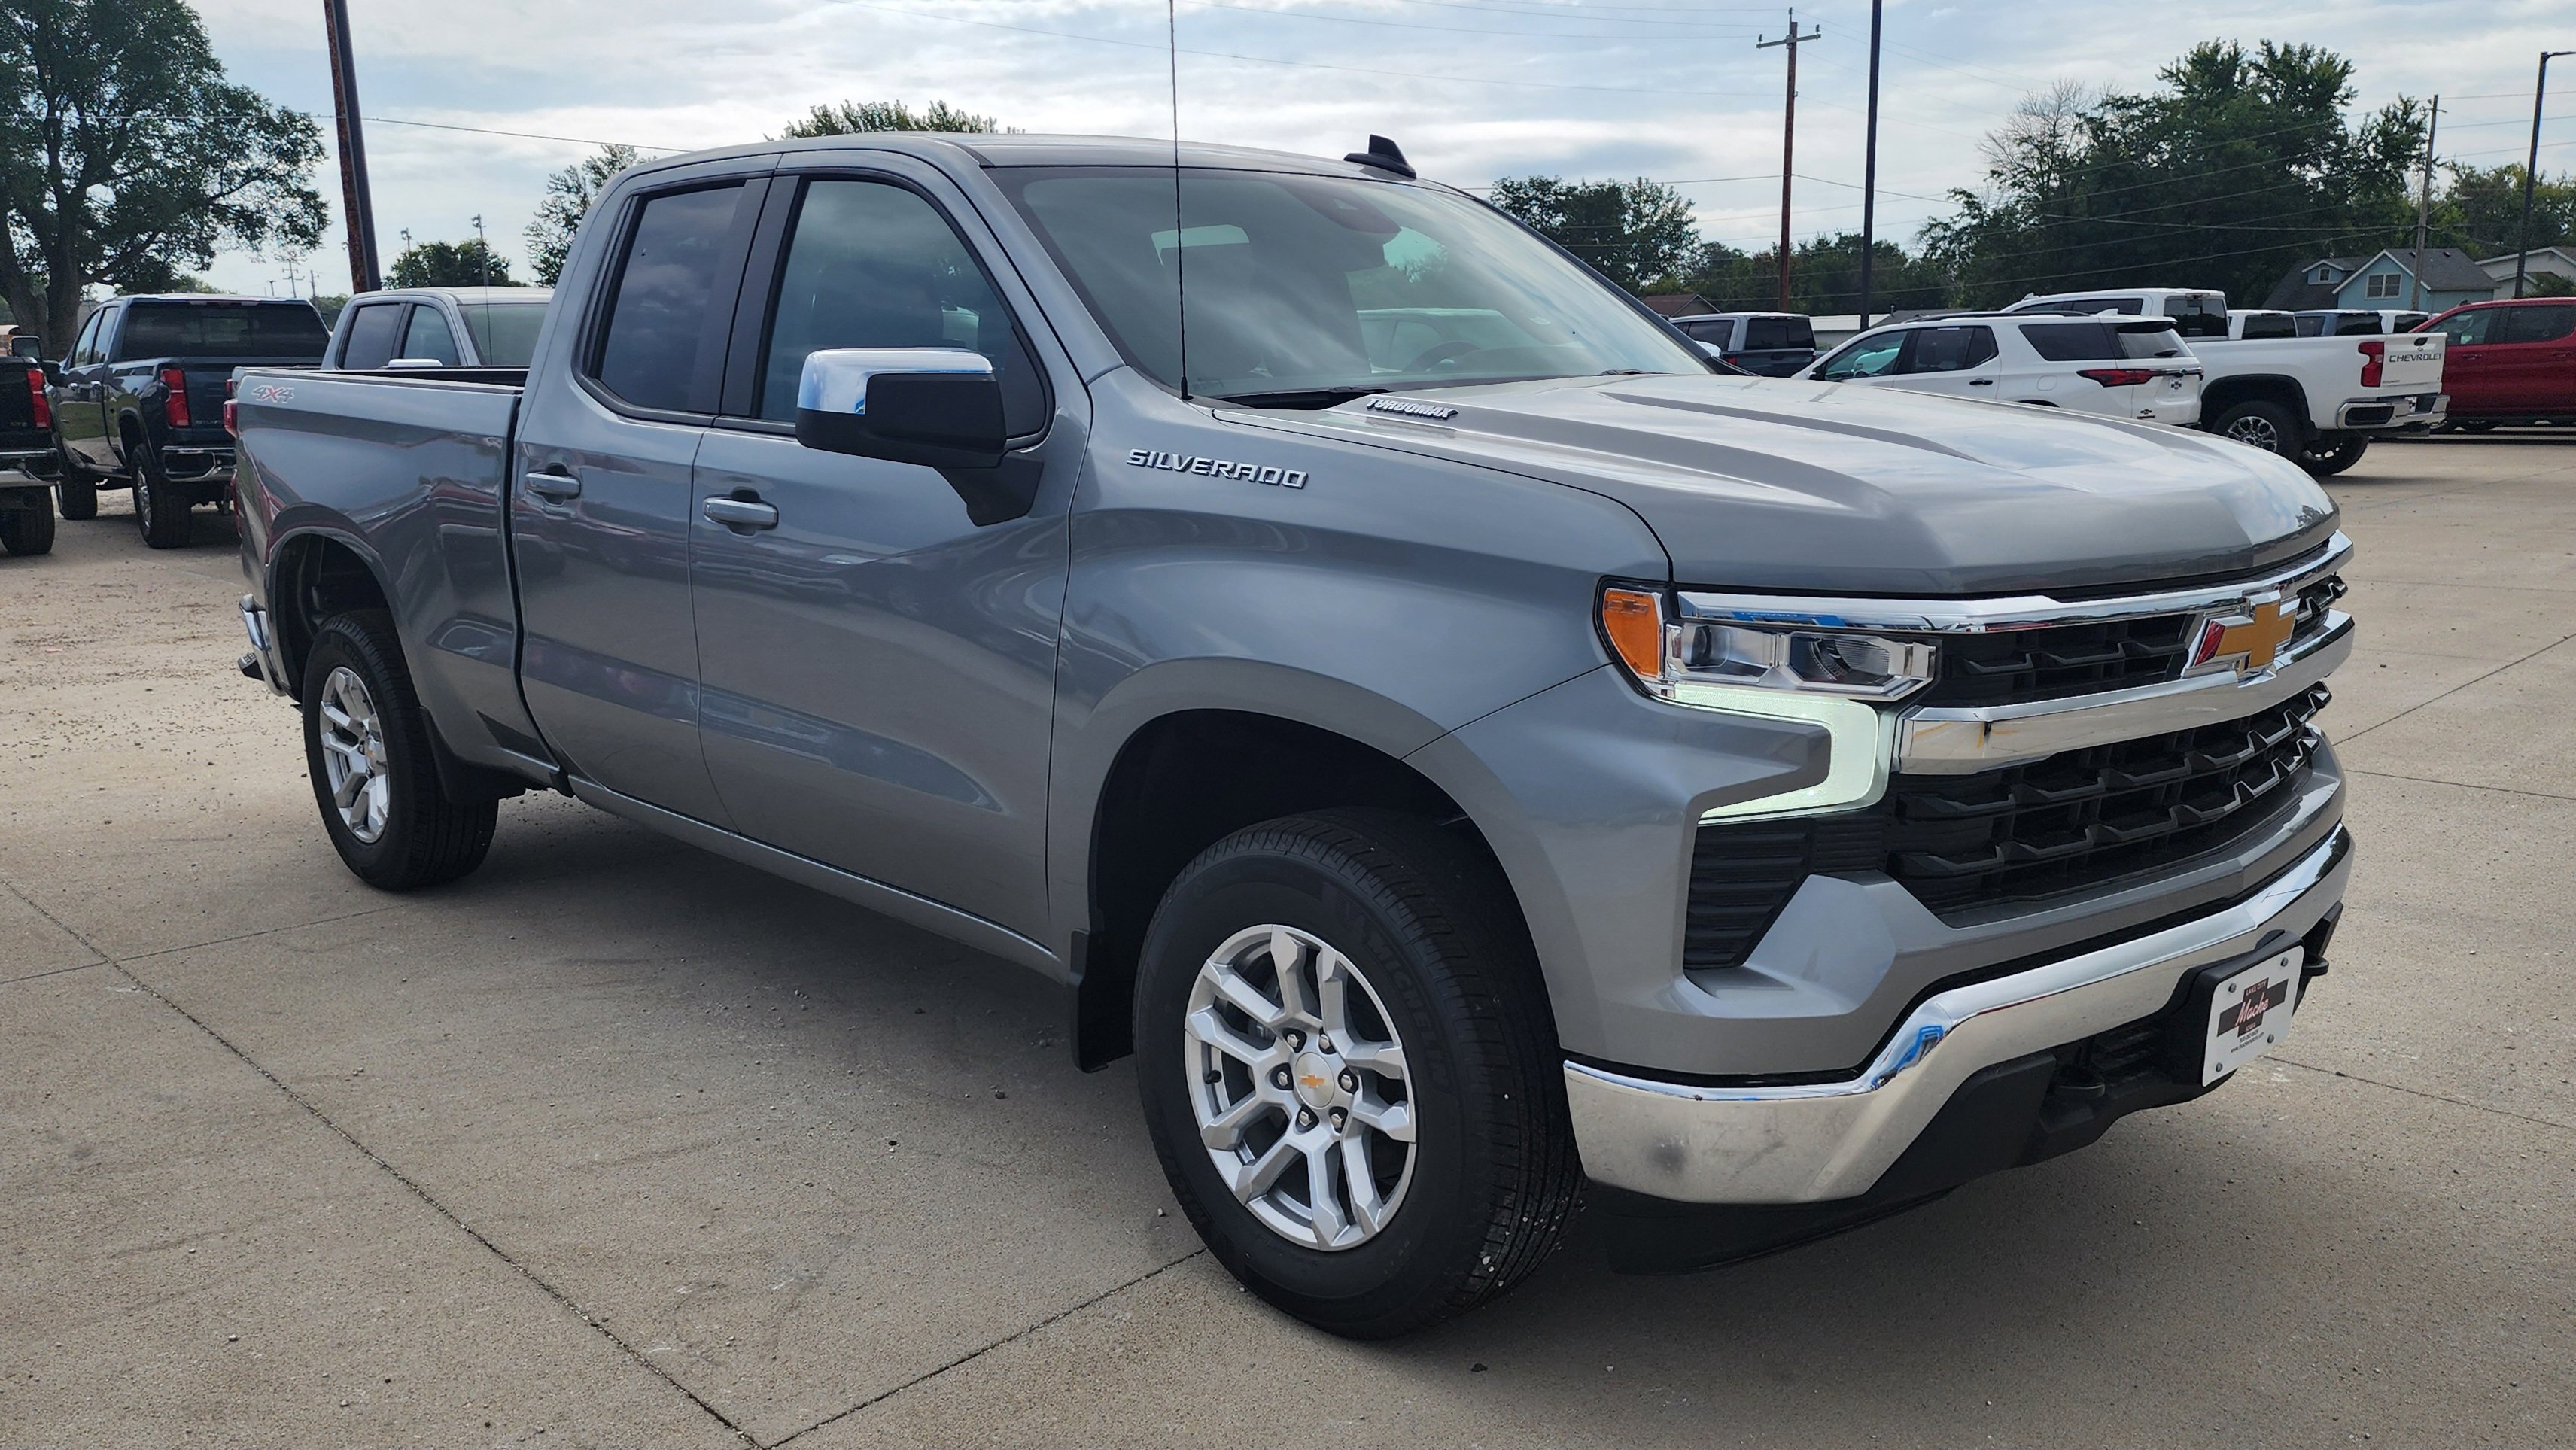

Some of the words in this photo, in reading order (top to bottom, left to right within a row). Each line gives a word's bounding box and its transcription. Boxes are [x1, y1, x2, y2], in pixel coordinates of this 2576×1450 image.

[2389, 353, 2442, 363] CHEVROLET
[1366, 398, 1458, 420] TURBOMAX
[1127, 448, 1309, 489] SILVERADO
[2246, 986, 2257, 996] LAKE
[1364, 938, 1450, 1083] MICHELIN
